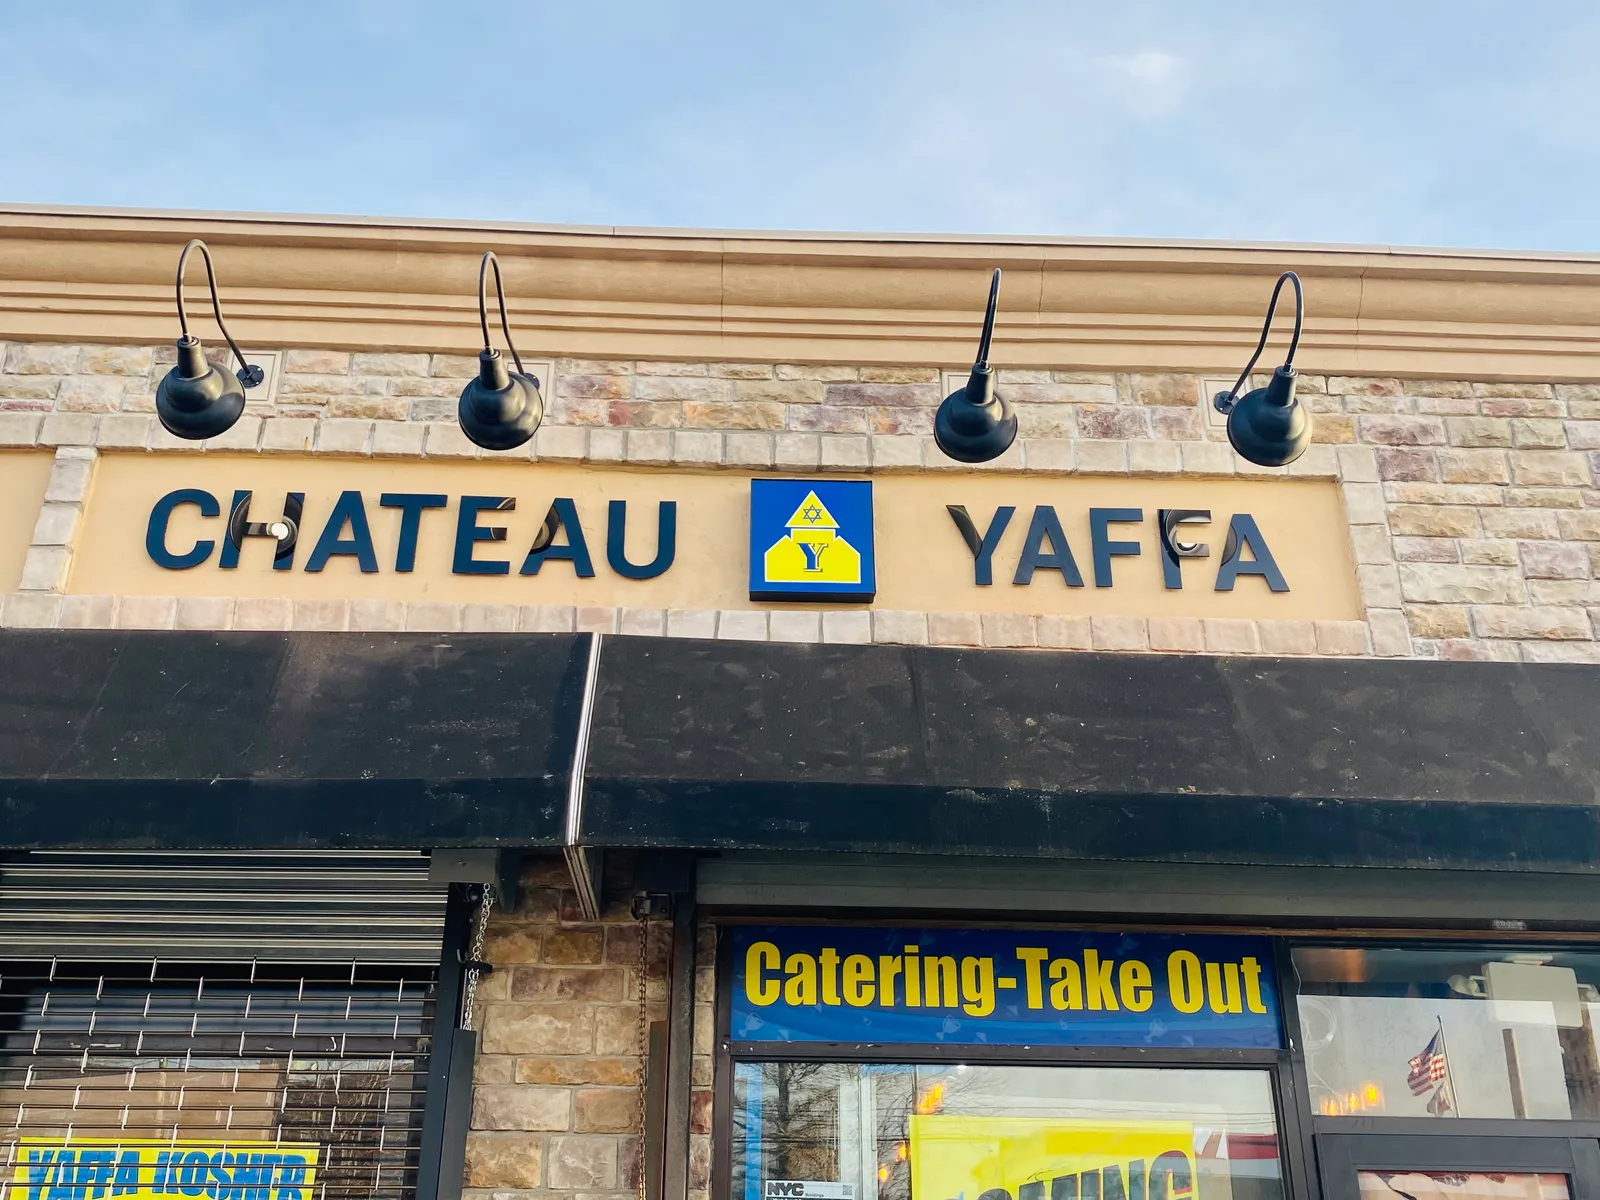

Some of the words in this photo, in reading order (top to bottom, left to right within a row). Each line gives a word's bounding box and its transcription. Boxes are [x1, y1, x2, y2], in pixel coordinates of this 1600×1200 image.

[145, 488, 677, 579] CHATEAU
[796, 542, 829, 573] Y
[945, 504, 1290, 593] YAFFA
[744, 941, 1153, 1017] Catering-Take
[1166, 949, 1268, 1015] Out
[28, 1150, 140, 1200] YAFFA
[152, 1151, 307, 1200] KOSHER
[767, 1182, 804, 1197] NYC
